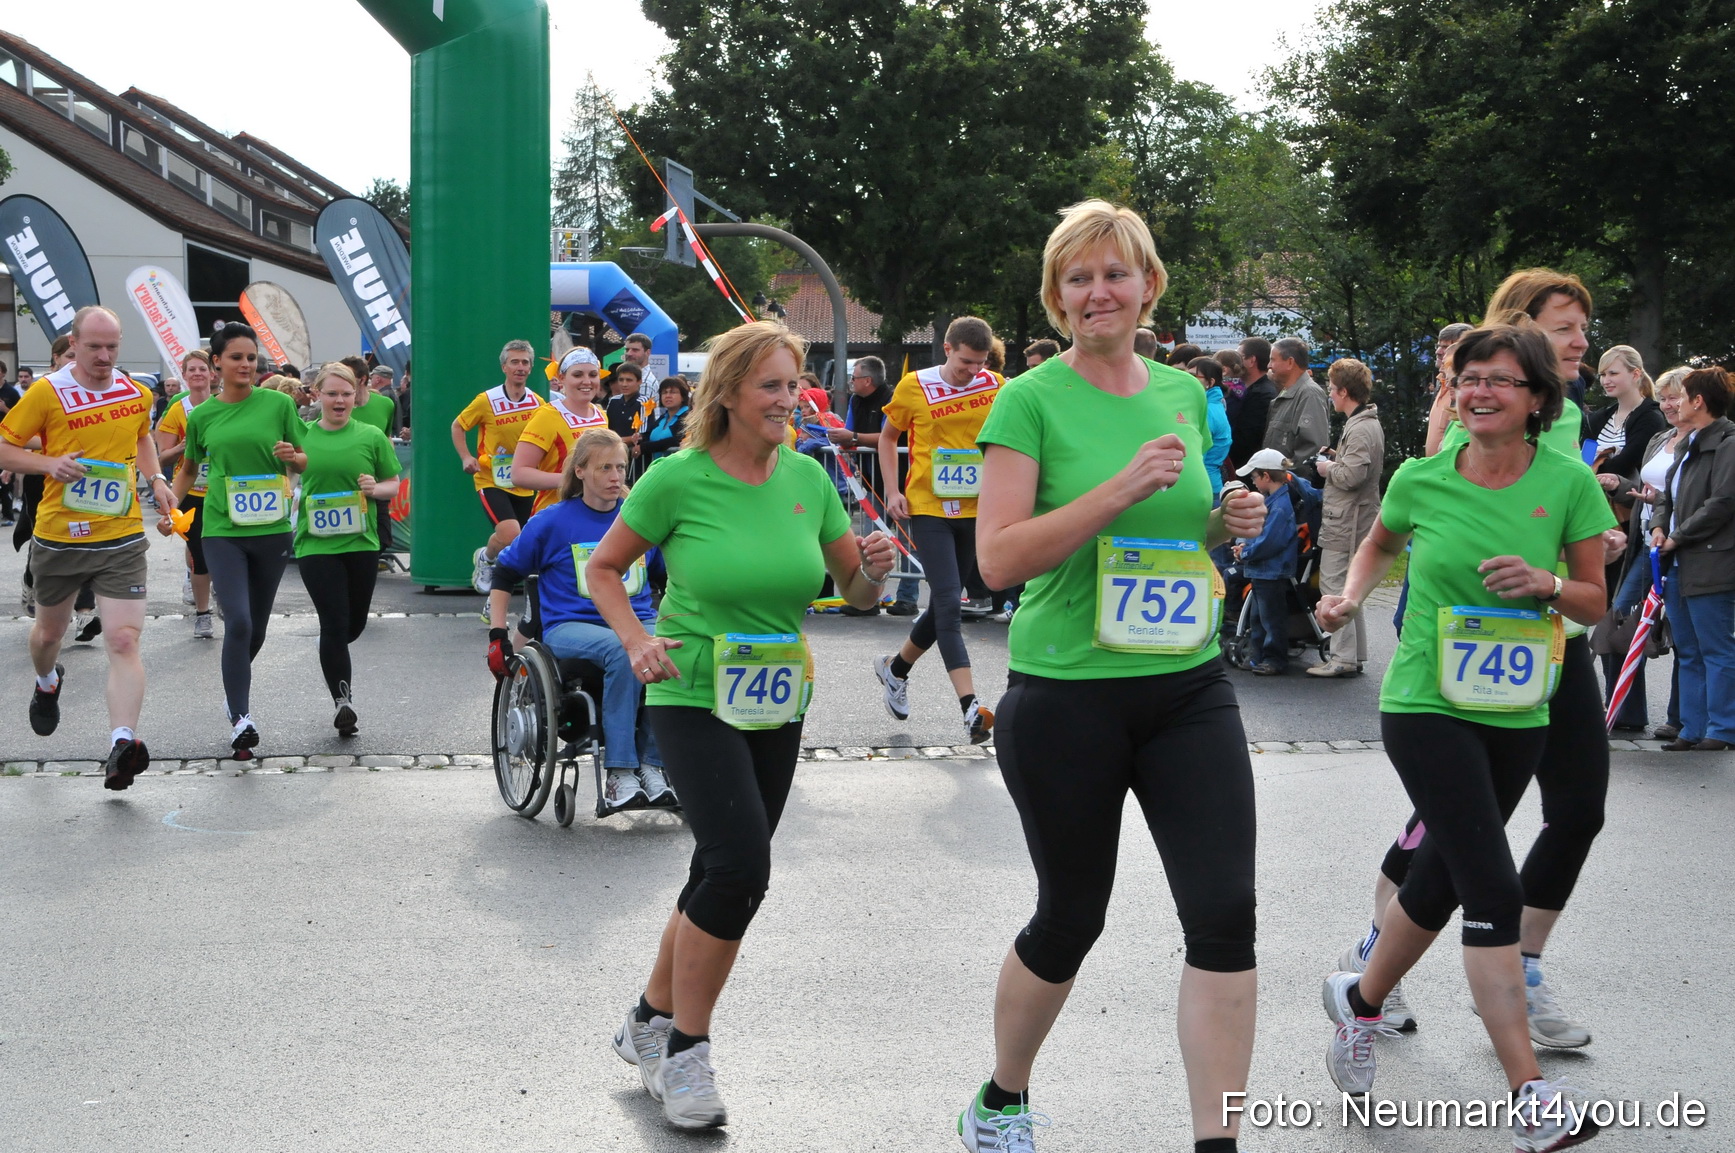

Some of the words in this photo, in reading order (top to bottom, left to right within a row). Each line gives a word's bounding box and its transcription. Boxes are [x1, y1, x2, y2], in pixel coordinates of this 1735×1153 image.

[67, 412, 106, 430] MAX
[110, 402, 146, 420] BÖGL
[496, 414, 518, 426] MAX
[930, 400, 968, 420] MAX
[938, 466, 977, 485] 443
[70, 476, 120, 503] 416
[234, 492, 278, 512] 802
[314, 507, 352, 528] 801
[1112, 578, 1196, 624] 752
[1128, 624, 1164, 636] Renate
[1454, 642, 1534, 686] 749
[726, 667, 792, 705] 746
[1472, 684, 1492, 695] Rita
[732, 706, 764, 715] Theresia
